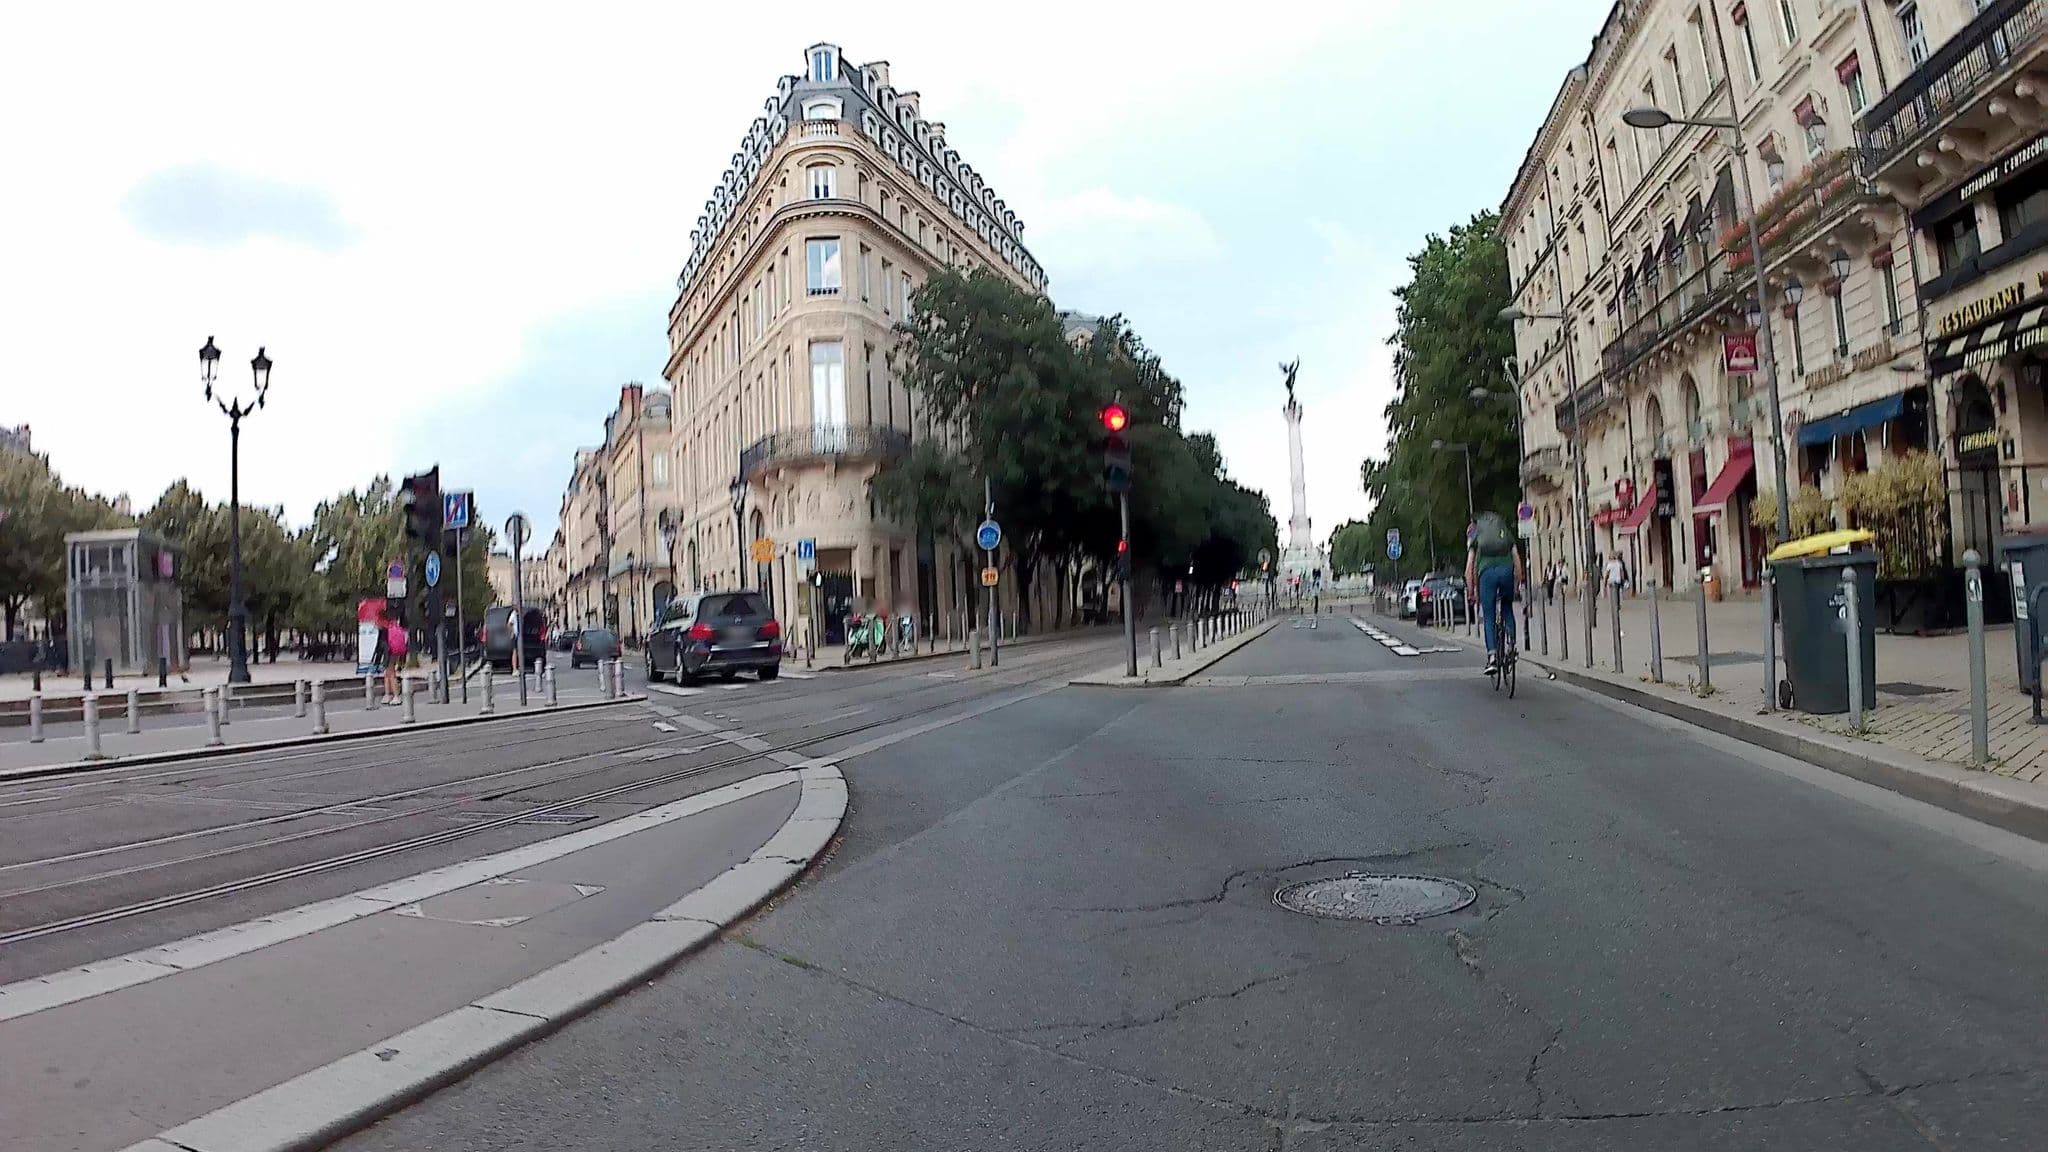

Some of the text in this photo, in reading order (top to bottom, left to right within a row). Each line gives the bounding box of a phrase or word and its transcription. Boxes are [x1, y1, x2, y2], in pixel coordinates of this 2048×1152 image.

[1960, 166, 1998, 201] RESTAURANT
[1936, 282, 2024, 337] RESTAURANT
[1963, 339, 2008, 367] RESTAURANT
